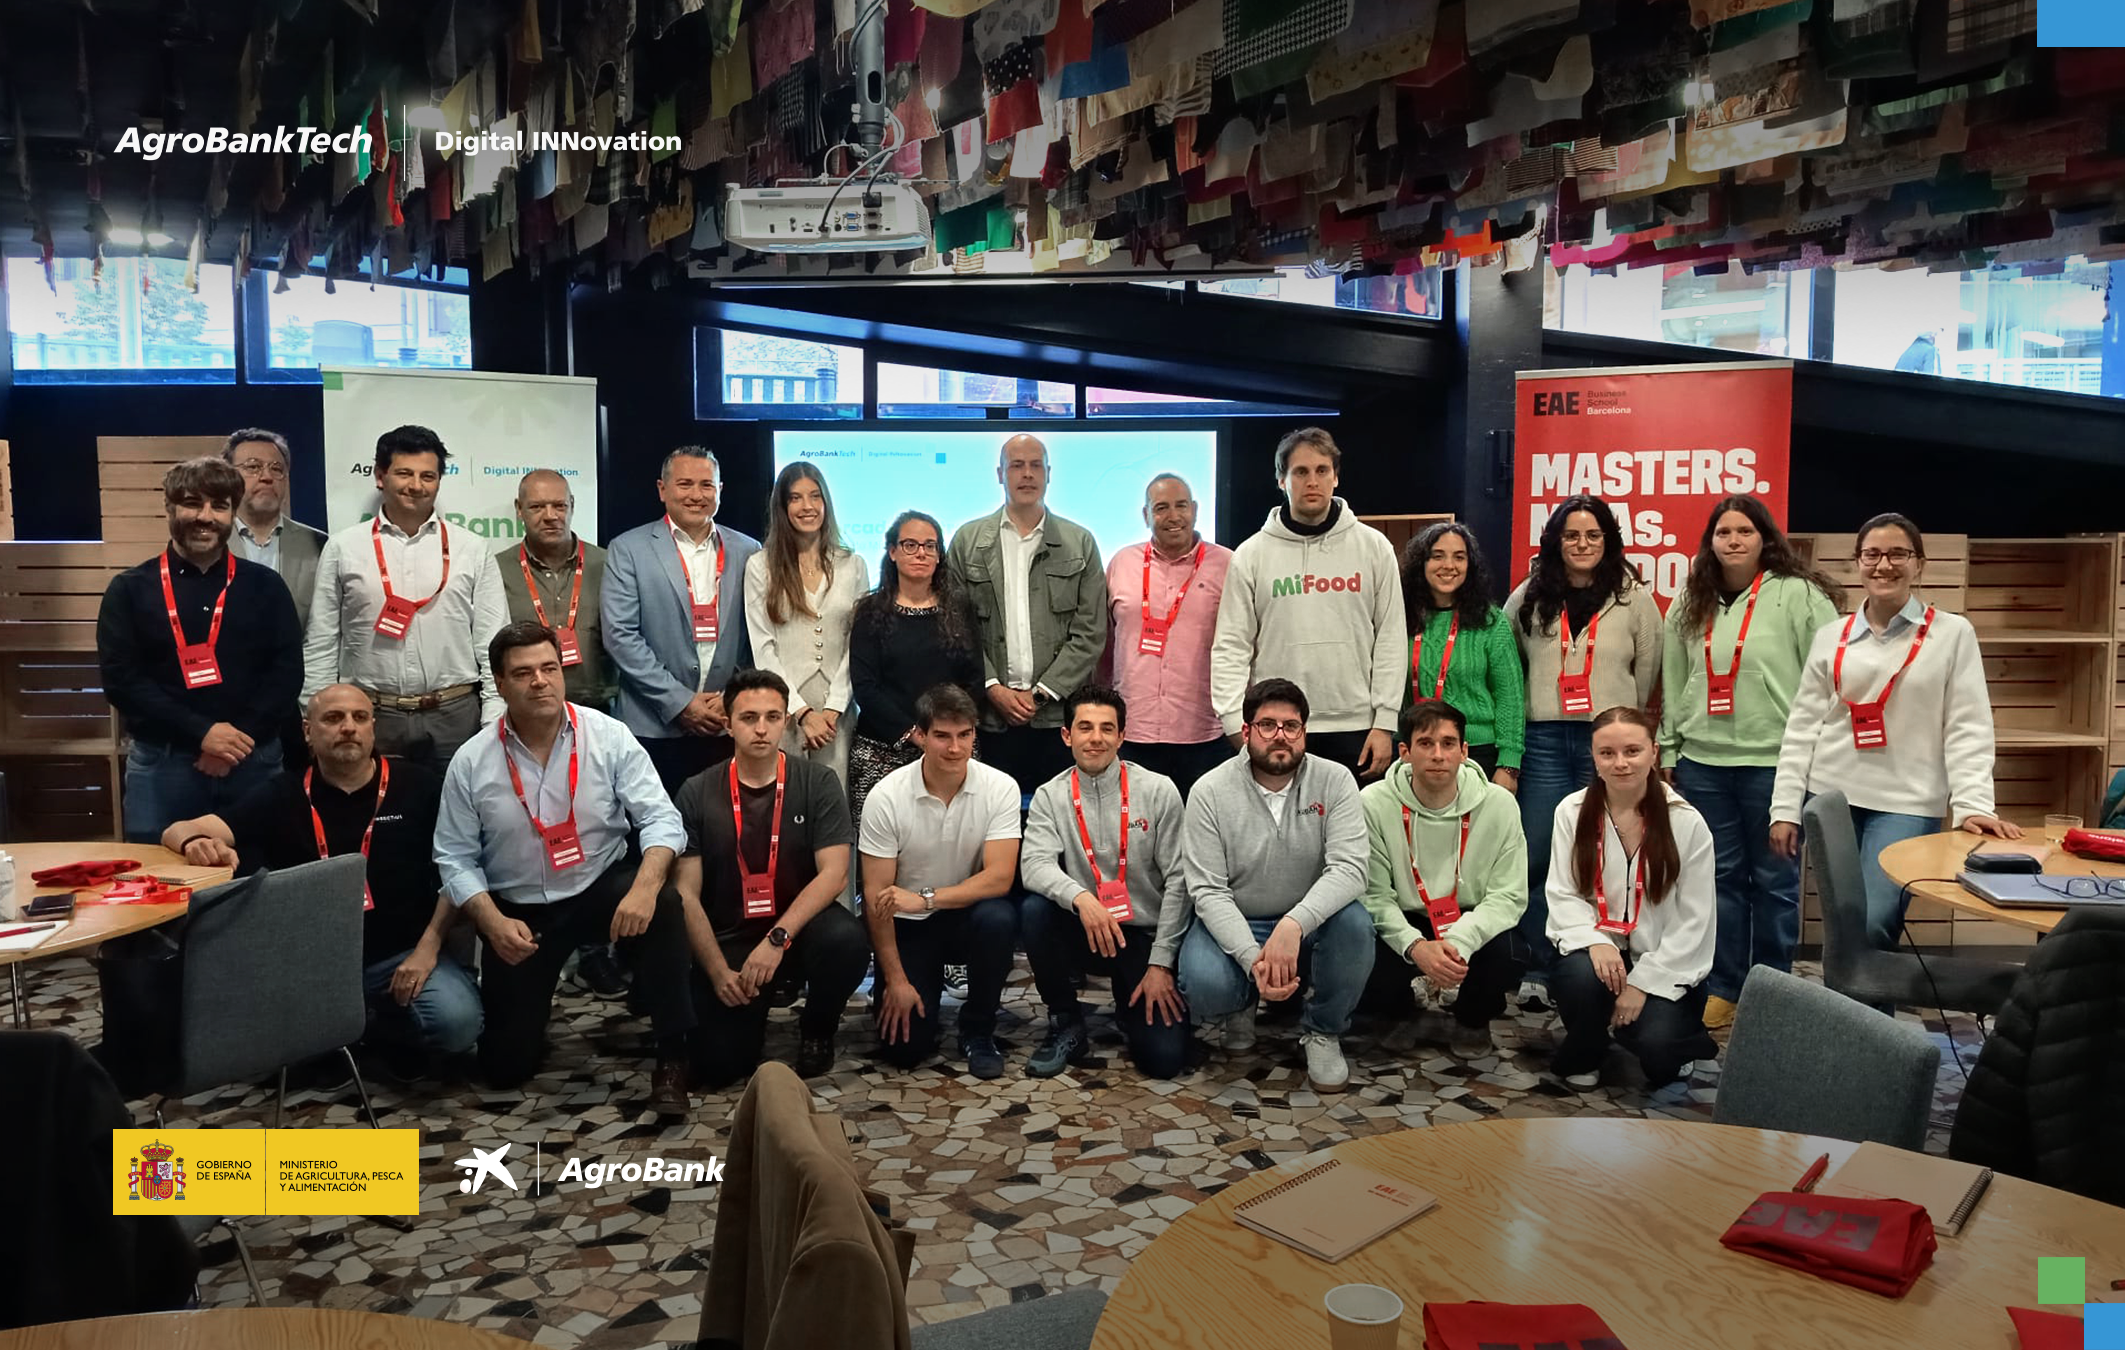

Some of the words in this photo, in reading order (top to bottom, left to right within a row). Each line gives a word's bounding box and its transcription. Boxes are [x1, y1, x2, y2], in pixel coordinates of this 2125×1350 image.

[1587, 390, 1627, 398] Business
[1534, 391, 1580, 416] EAE
[1587, 398, 1618, 406] School
[1587, 406, 1632, 415] Barcelona
[800, 450, 856, 459] AgroBankTech
[483, 466, 519, 477] Digital
[1531, 448, 1770, 497] MASTERS.
[1530, 503, 1677, 547] MAs.
[1272, 572, 1362, 598] MiFood
